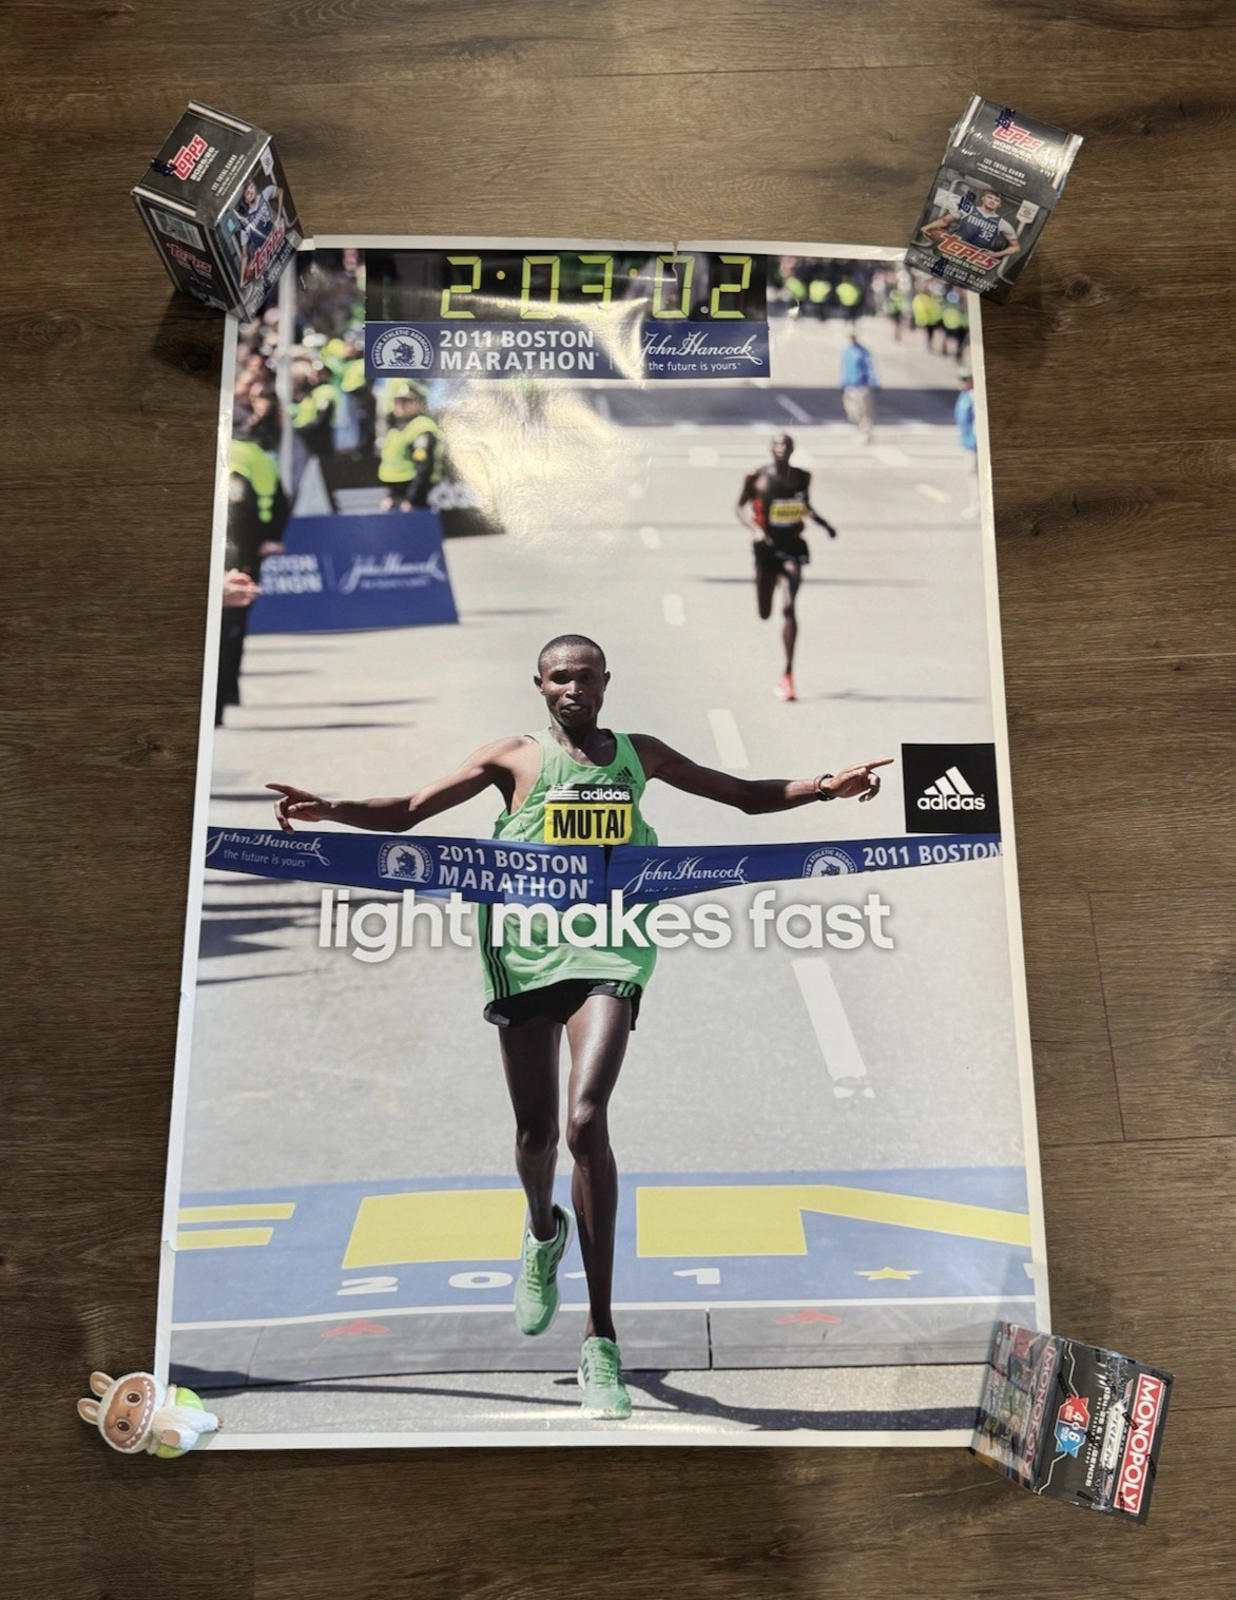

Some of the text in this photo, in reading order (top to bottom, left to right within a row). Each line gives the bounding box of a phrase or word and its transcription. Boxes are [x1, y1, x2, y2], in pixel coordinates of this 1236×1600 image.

[440, 330, 594, 349] 2011 BOSTON
[642, 331, 680, 359] John
[440, 351, 595, 371] MARATHON
[649, 361, 738, 373] the future is yours
[580, 788, 631, 801] adidas
[917, 795, 987, 811] adidas
[552, 809, 626, 839] MUTAI
[206, 831, 330, 866] John Hancock
[223, 849, 306, 868] the future is yours
[437, 845, 588, 876] 2011 BOSTON
[862, 842, 1003, 867] 2011 BOSTON
[438, 865, 588, 900] MARATHON
[623, 855, 751, 898] John Hancock
[318, 888, 895, 963] light makes fast
[1072, 1411, 1084, 1422] 4
[1068, 1432, 1080, 1442] 6
[1122, 1379, 1159, 1509] MONOPOLY
